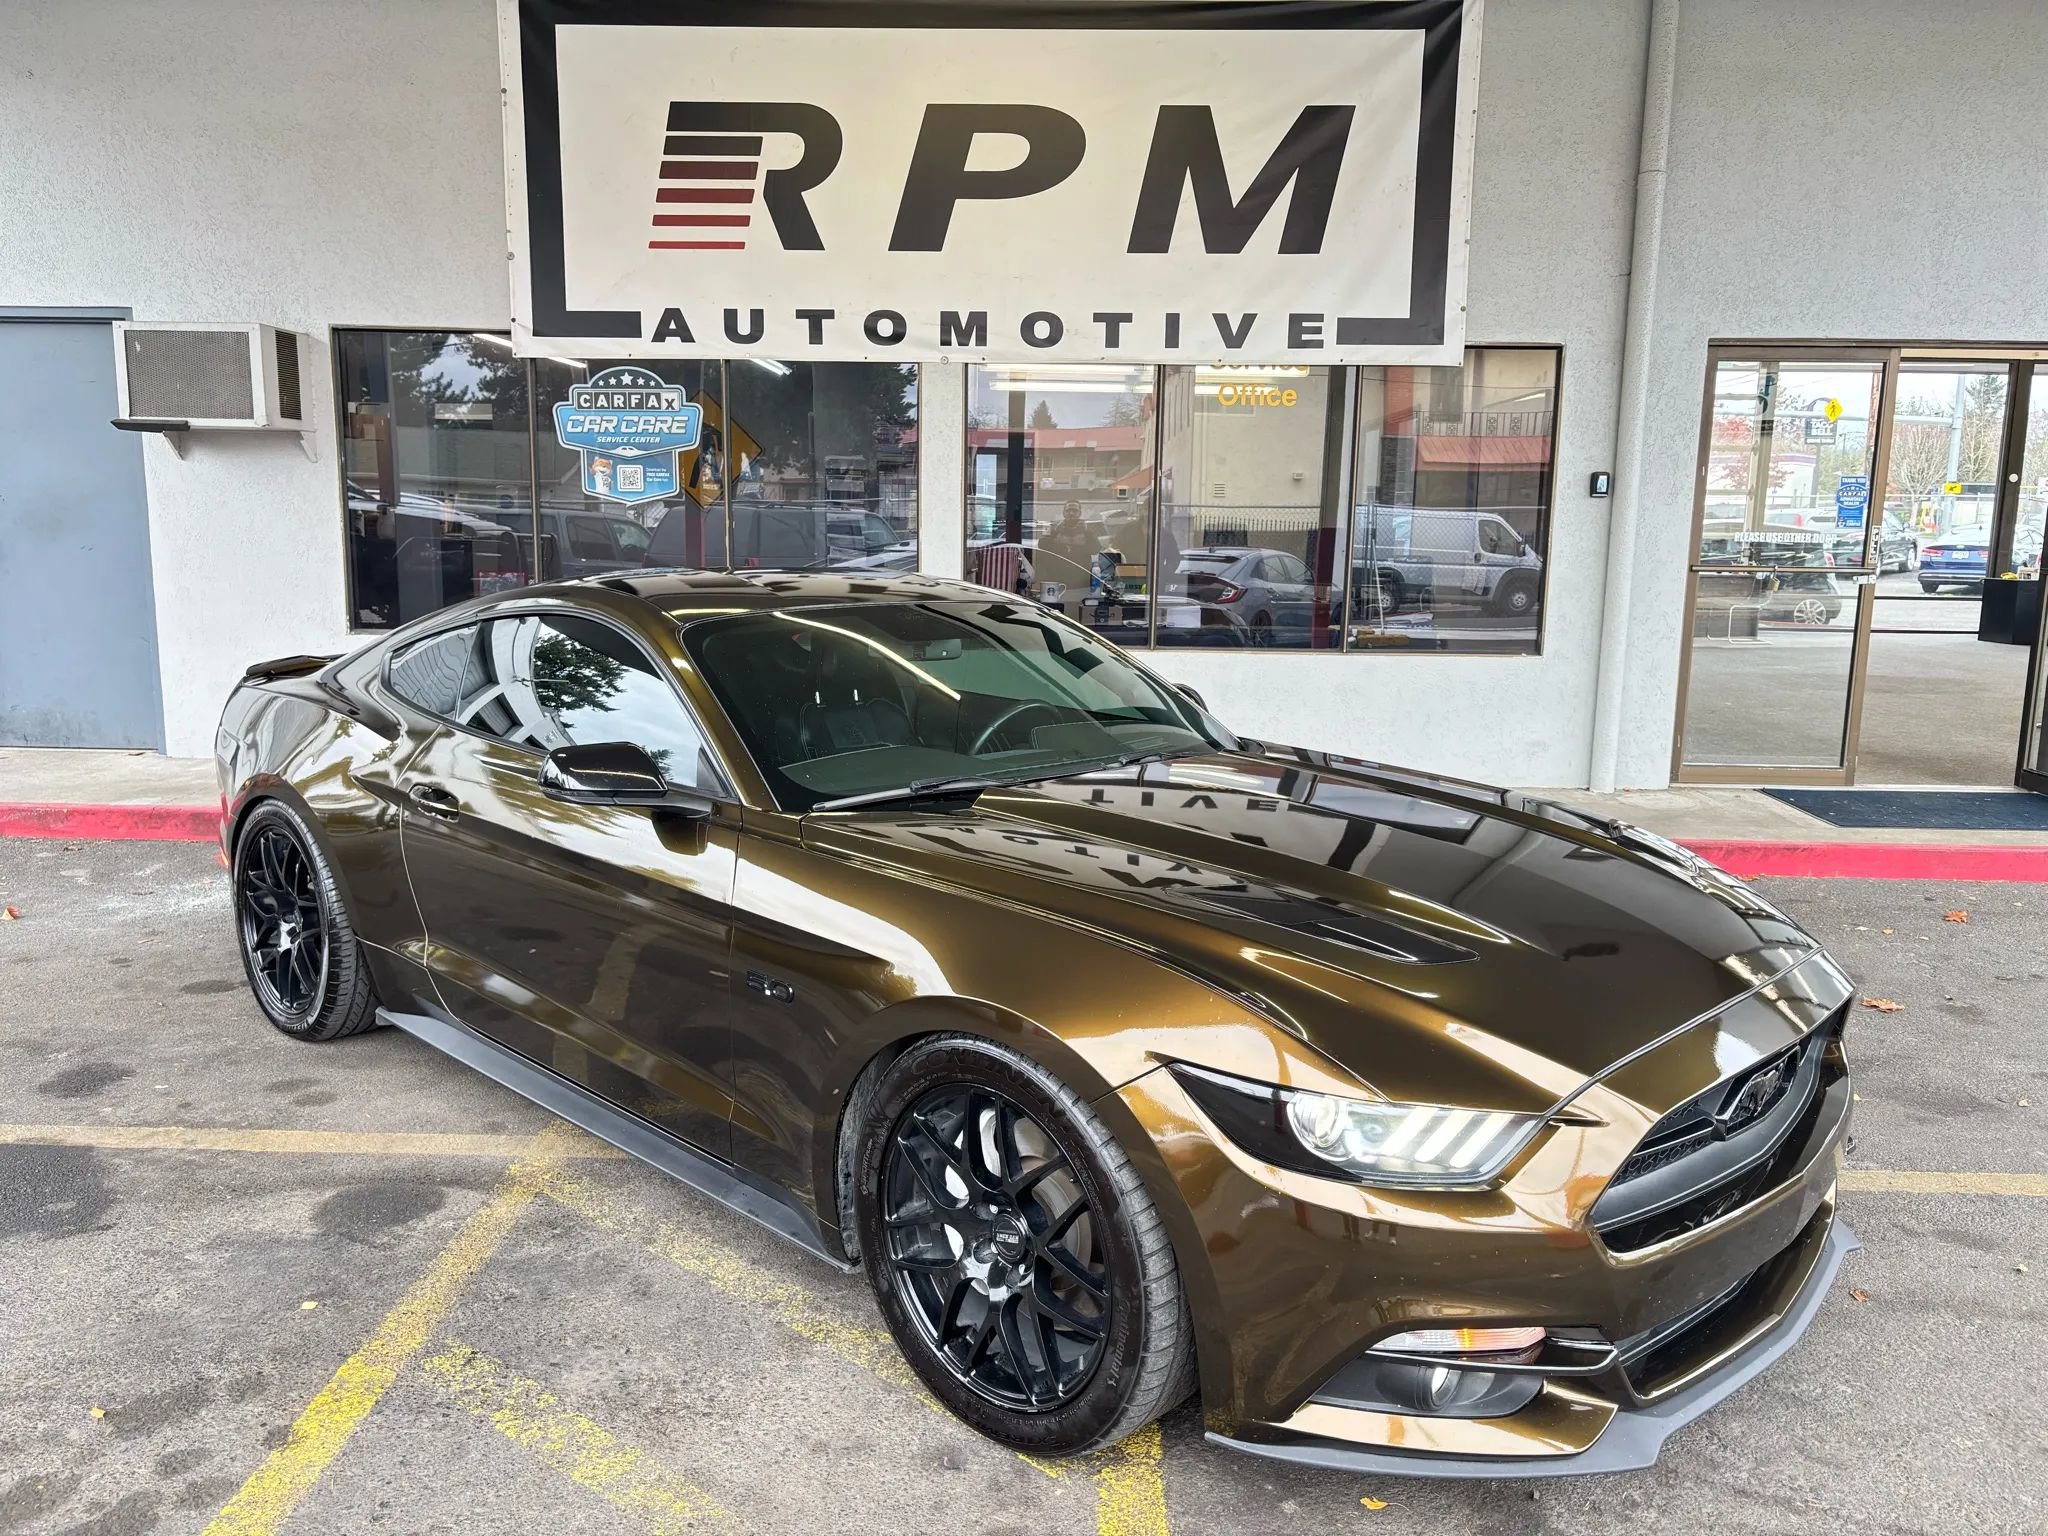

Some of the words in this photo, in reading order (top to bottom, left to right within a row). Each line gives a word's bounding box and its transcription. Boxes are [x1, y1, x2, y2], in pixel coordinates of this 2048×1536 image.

[648, 101, 1356, 255] RPM
[651, 307, 1325, 349] AUTOMOTIVE
[579, 394, 676, 411] CARFAX
[1218, 383, 1297, 407] Office
[566, 415, 619, 433] CAR
[620, 415, 689, 434] CARE
[630, 436, 661, 444] CENTER
[1734, 531, 1766, 542] PLEASE
[1783, 533, 1812, 544] OTHER
[1813, 534, 1837, 545] DOOR
